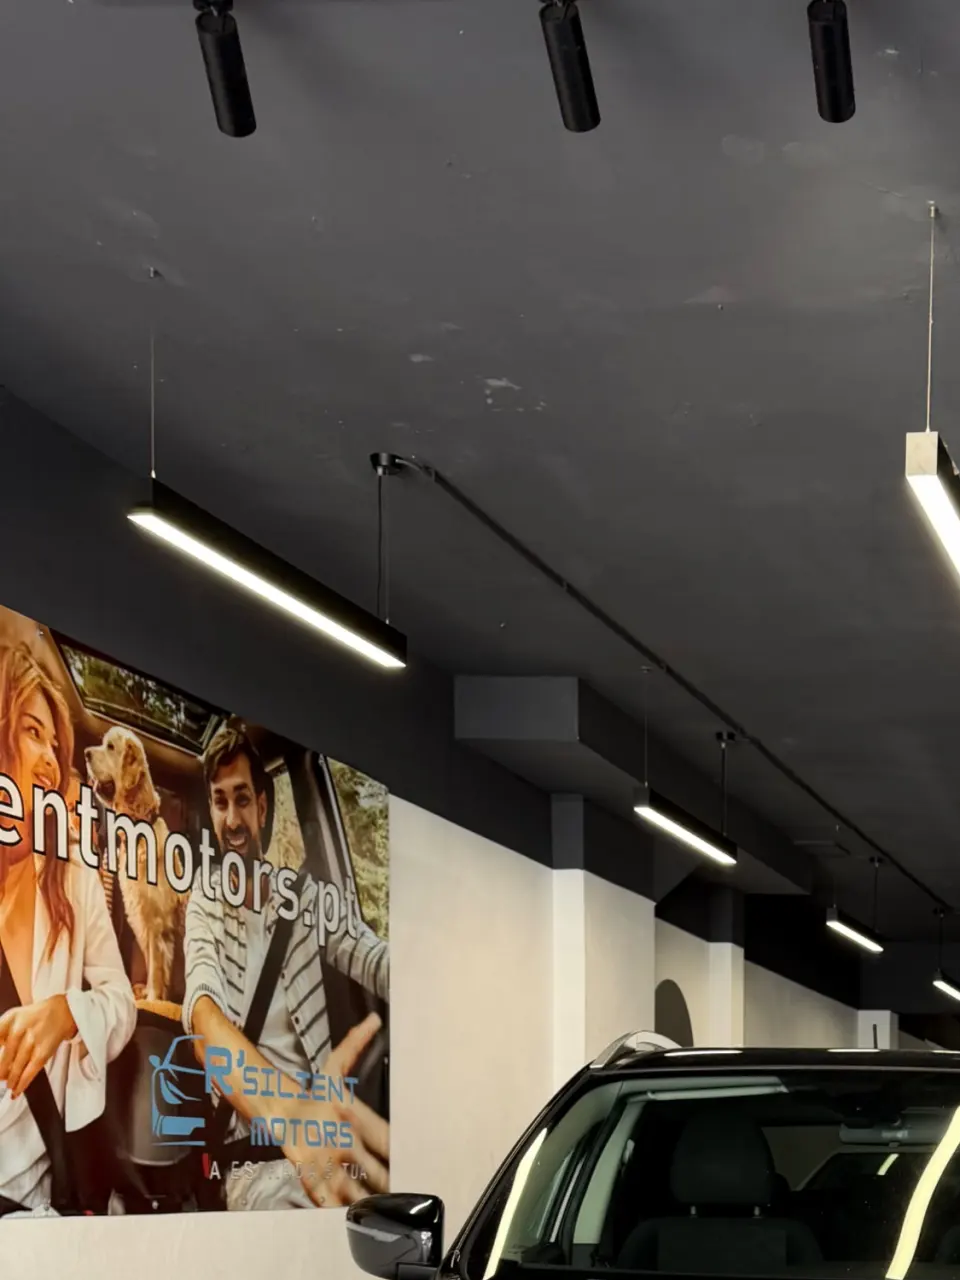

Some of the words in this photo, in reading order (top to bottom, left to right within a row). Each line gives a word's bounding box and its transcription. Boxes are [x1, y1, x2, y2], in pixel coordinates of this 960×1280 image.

[205, 1045, 359, 1105] R'SILIENT
[250, 1116, 354, 1149] MOTORS
[209, 1160, 222, 1180] A
[341, 1162, 369, 1181] TUA
